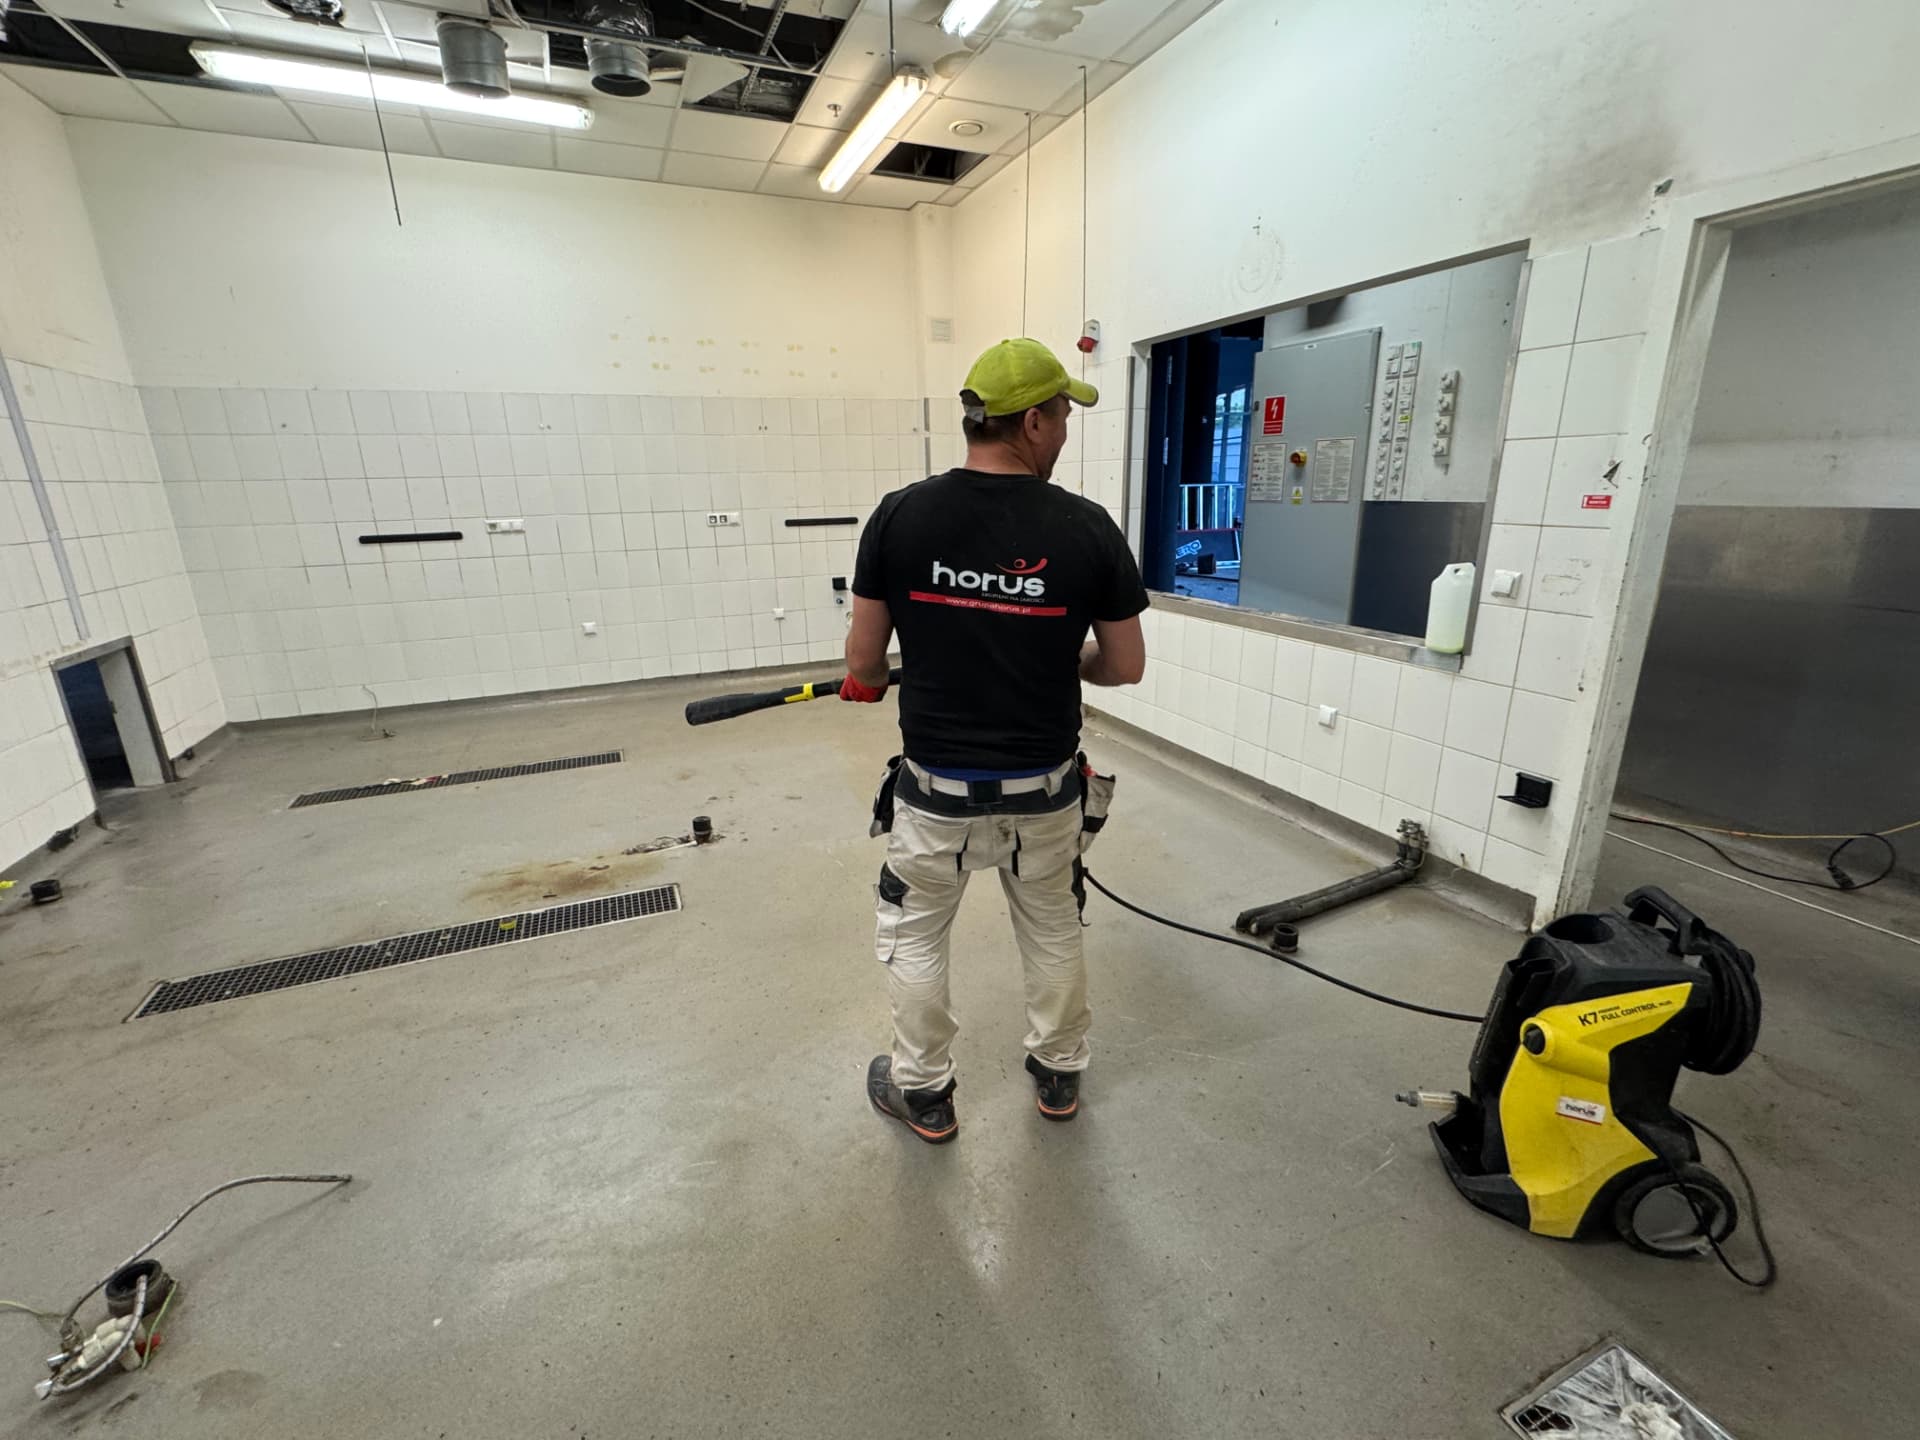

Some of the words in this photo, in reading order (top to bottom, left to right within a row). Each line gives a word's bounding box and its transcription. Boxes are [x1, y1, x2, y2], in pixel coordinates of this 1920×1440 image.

[932, 560, 1046, 597] horus
[1578, 1011, 1598, 1026] K7
[1601, 1011, 1620, 1021] FULL
[1620, 1002, 1658, 1016] CONTROL
